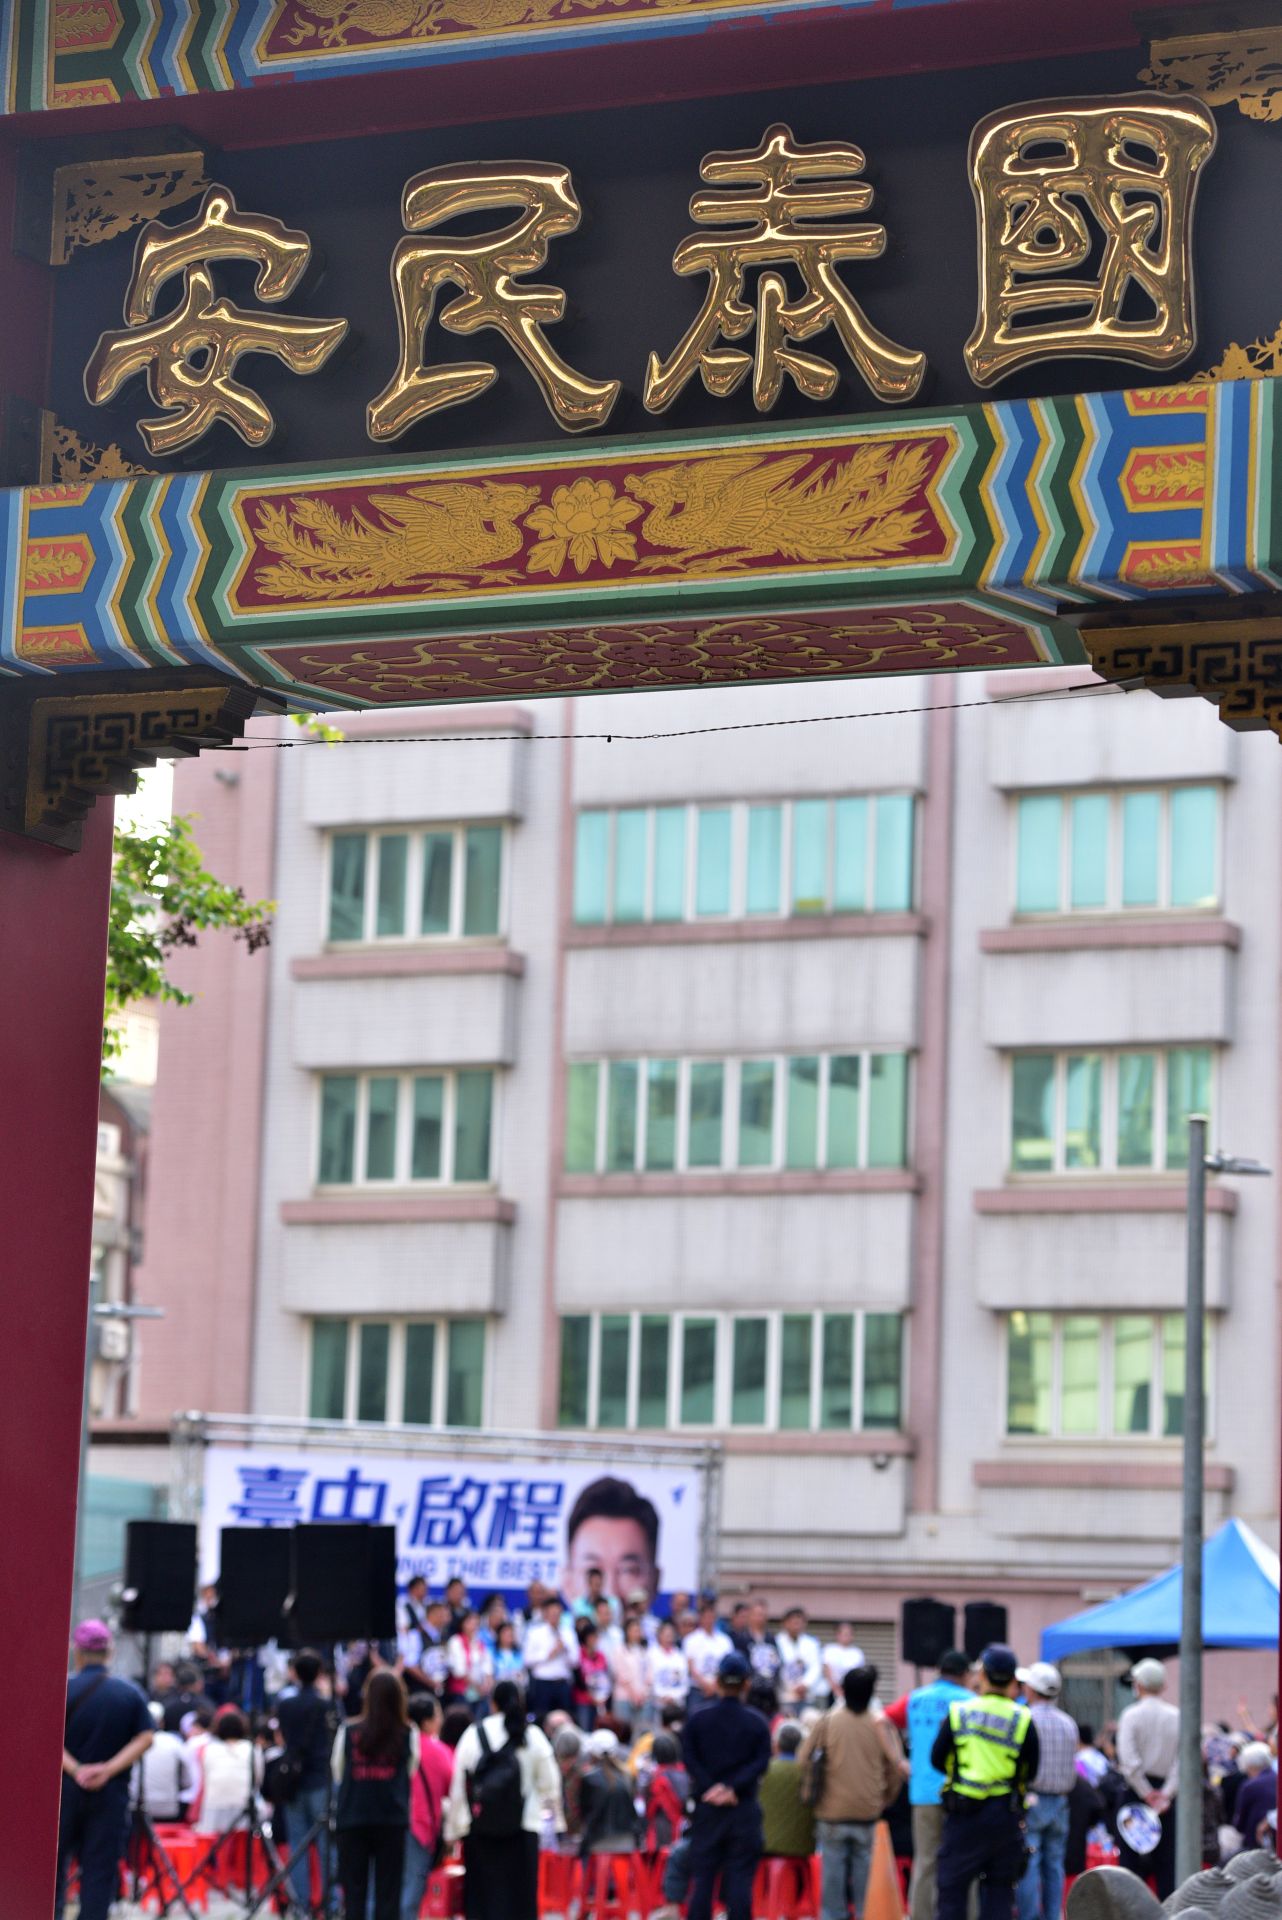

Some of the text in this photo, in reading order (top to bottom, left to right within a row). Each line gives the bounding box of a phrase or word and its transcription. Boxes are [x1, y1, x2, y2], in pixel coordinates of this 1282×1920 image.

[83, 91, 1217, 457] 國泰民安
[447, 1558, 488, 1579] THE
[498, 1559, 558, 1581] BEST
